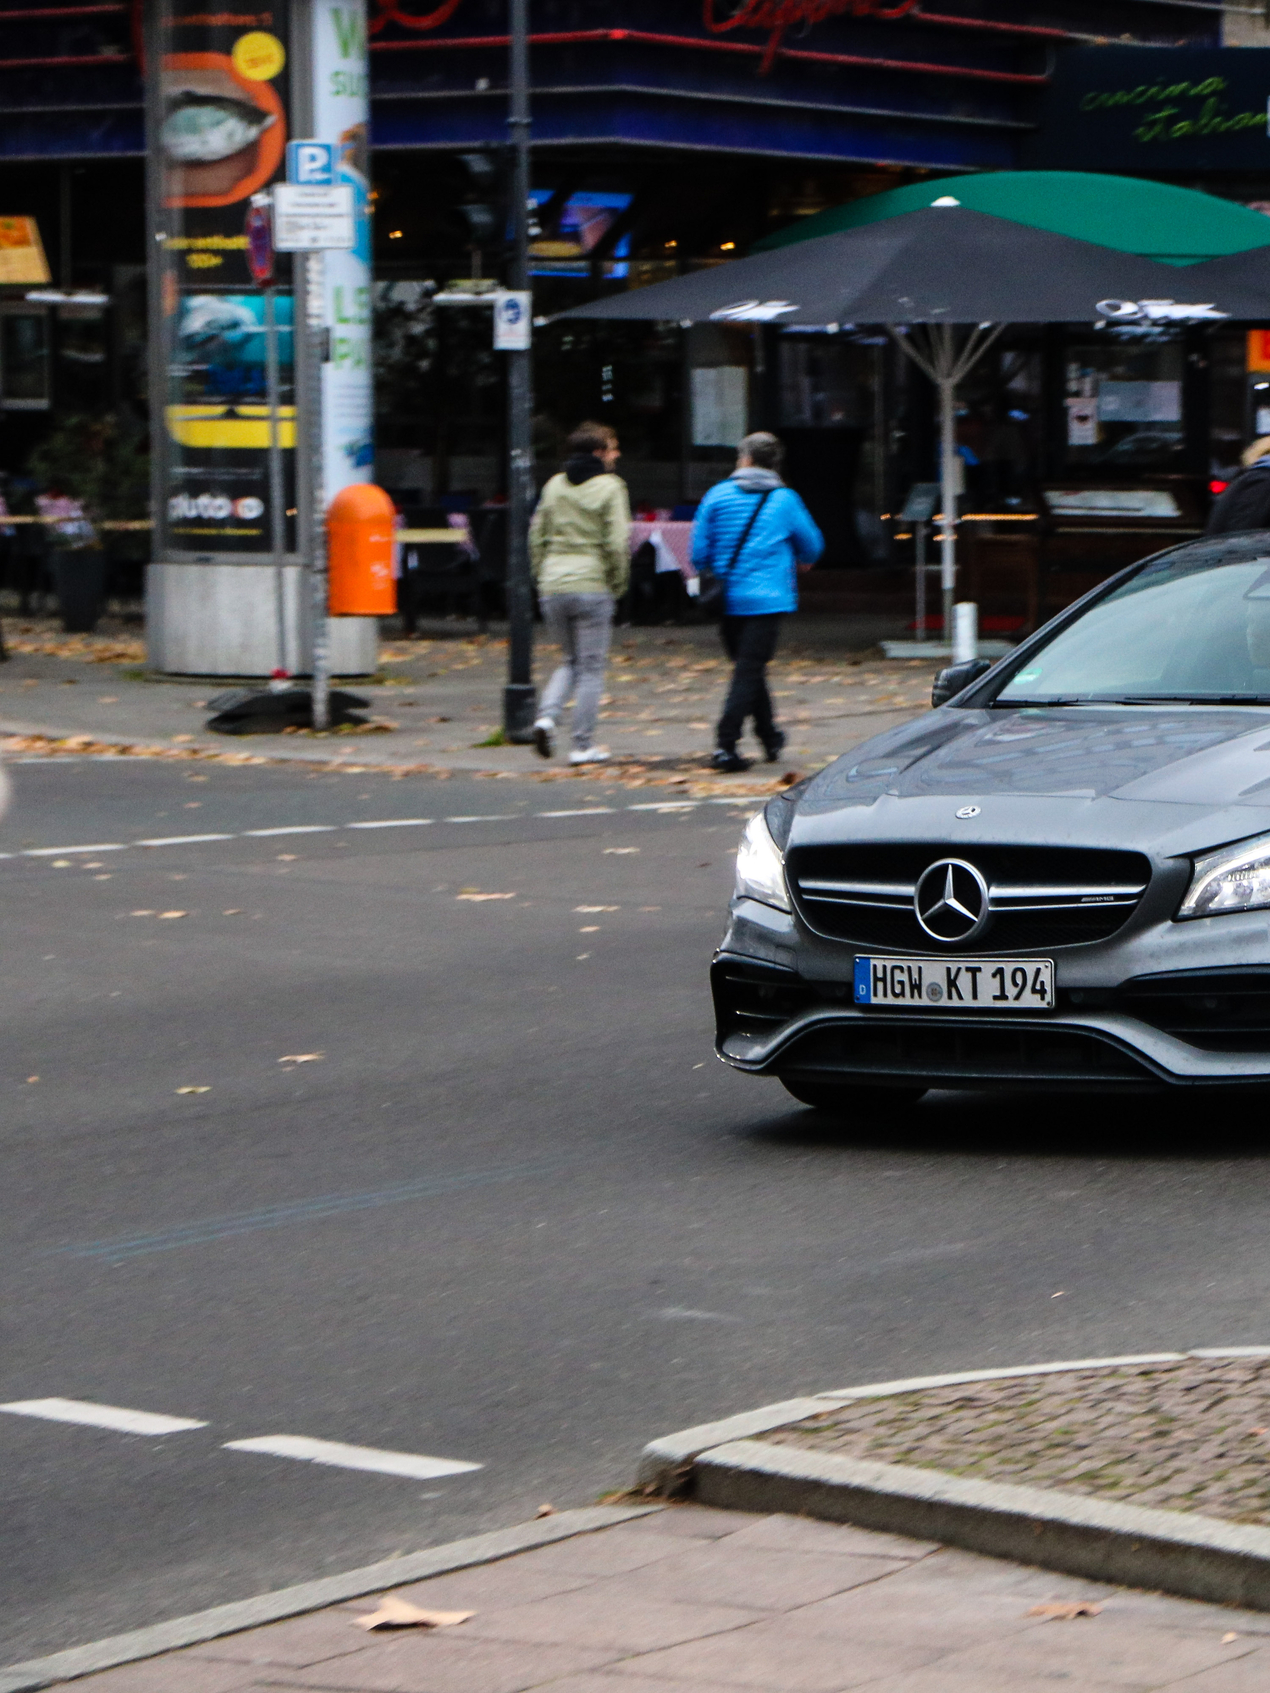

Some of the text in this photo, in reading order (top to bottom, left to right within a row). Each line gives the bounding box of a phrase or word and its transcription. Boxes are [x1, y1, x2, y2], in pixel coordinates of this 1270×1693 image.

[298, 145, 329, 182] P
[859, 963, 1048, 1001] D HGW KT 194
